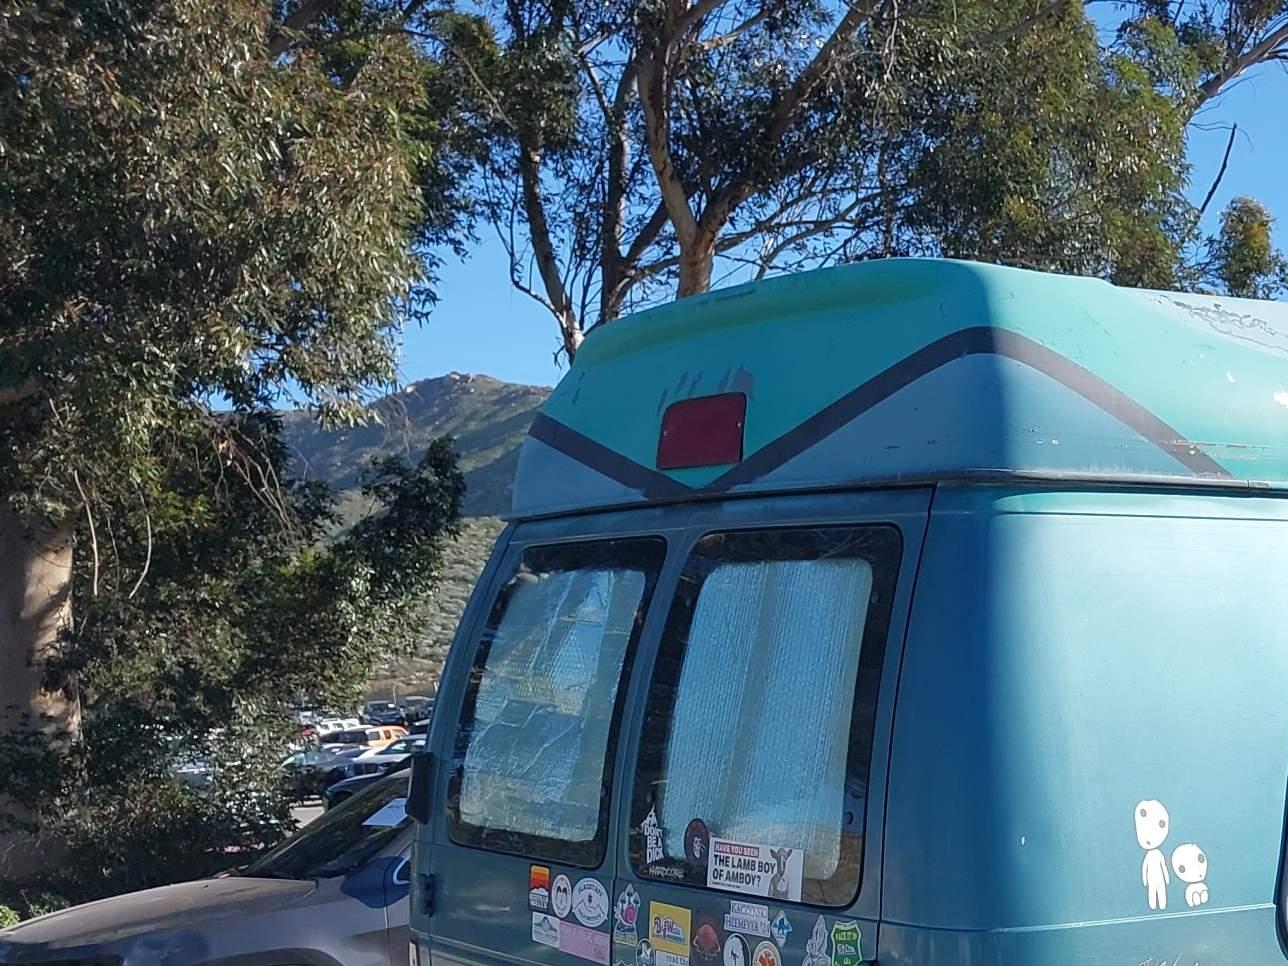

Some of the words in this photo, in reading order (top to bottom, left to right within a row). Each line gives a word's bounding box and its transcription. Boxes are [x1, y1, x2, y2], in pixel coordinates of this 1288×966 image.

[647, 836, 656, 848] BE
[715, 843, 730, 852] HAVE
[732, 845, 742, 854] YOU
[744, 847, 758, 856] SEEN
[646, 848, 664, 864] DICK
[714, 854, 730, 867] THE
[732, 857, 756, 871] LAMB
[758, 861, 776, 874] BOY
[713, 868, 723, 880] OF
[725, 871, 761, 887] AMBOY?
